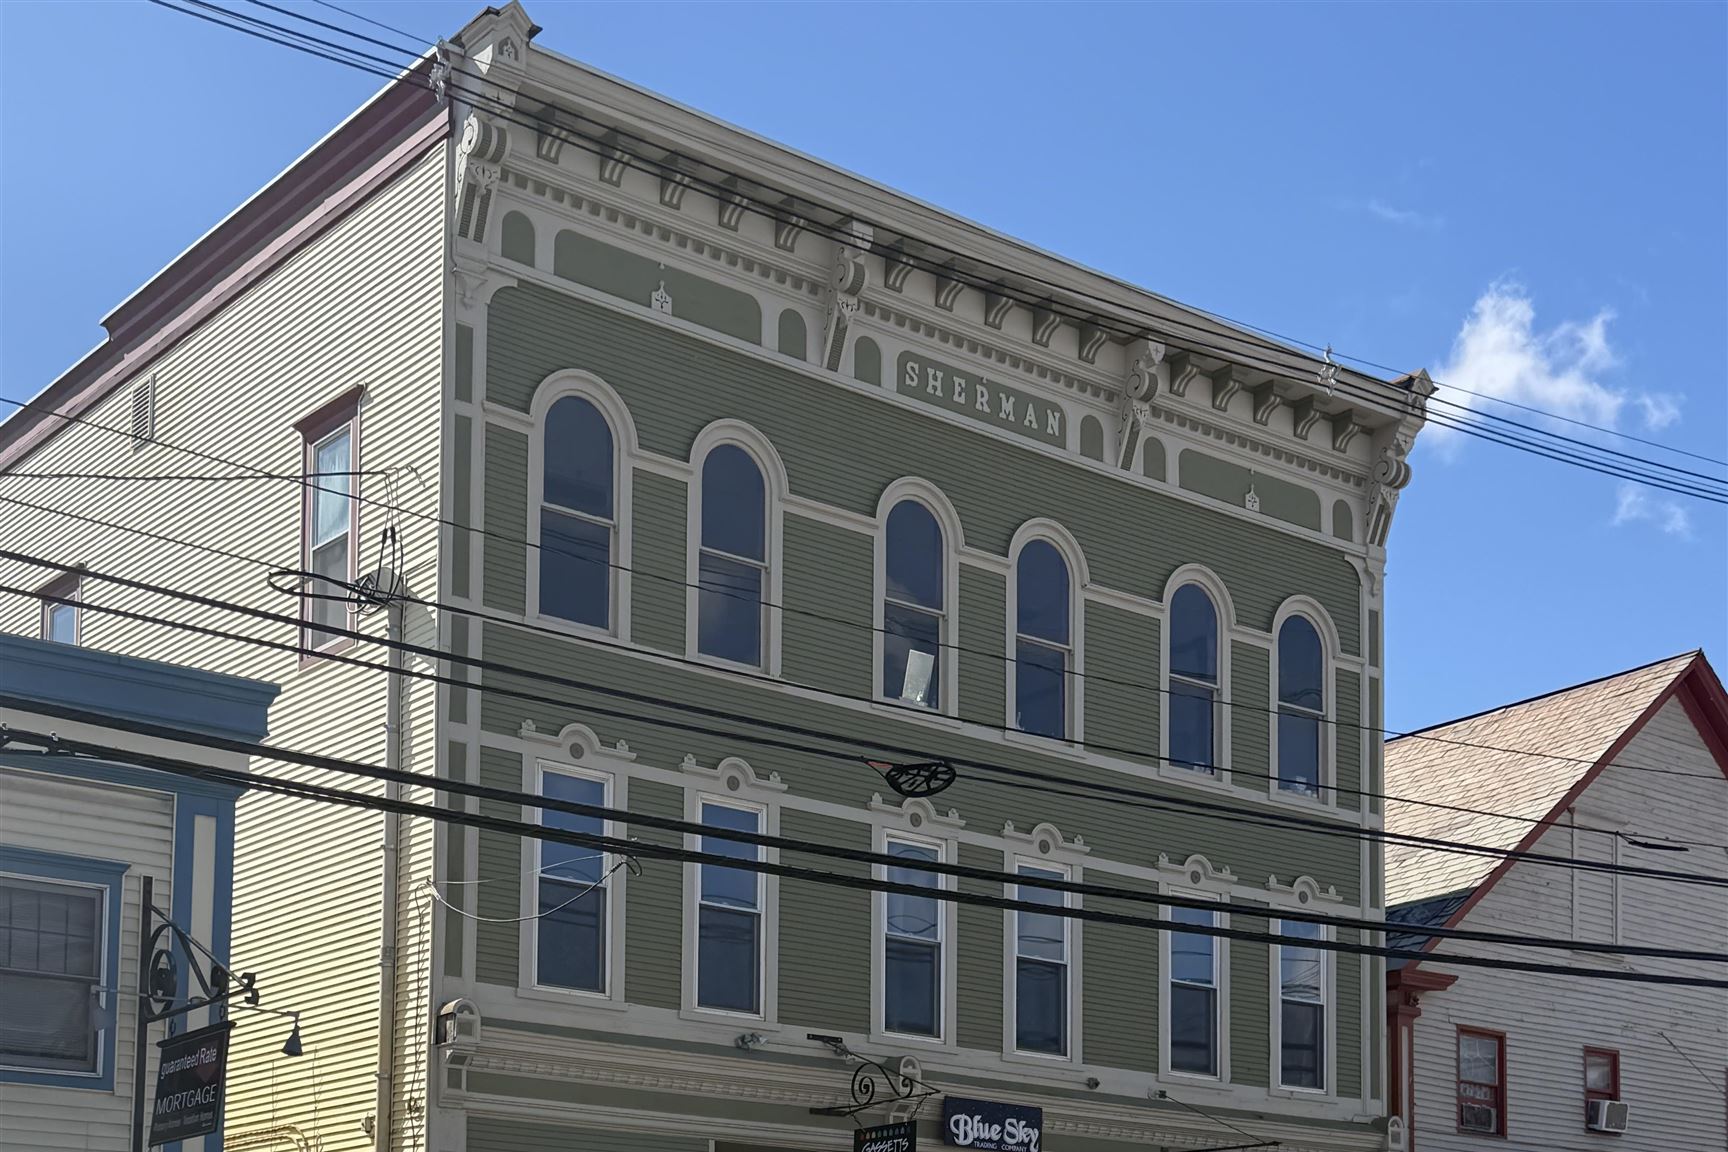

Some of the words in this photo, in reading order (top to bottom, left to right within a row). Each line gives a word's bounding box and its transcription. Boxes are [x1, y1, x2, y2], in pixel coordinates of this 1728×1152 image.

[905, 361, 1061, 437] SHERMAN
[199, 1047, 217, 1065] Rate
[155, 1083, 217, 1115] MORTGAGE
[949, 1113, 1002, 1146] Blue
[974, 1140, 998, 1150] TRADING
[1001, 1143, 1028, 1152] COMPANY
